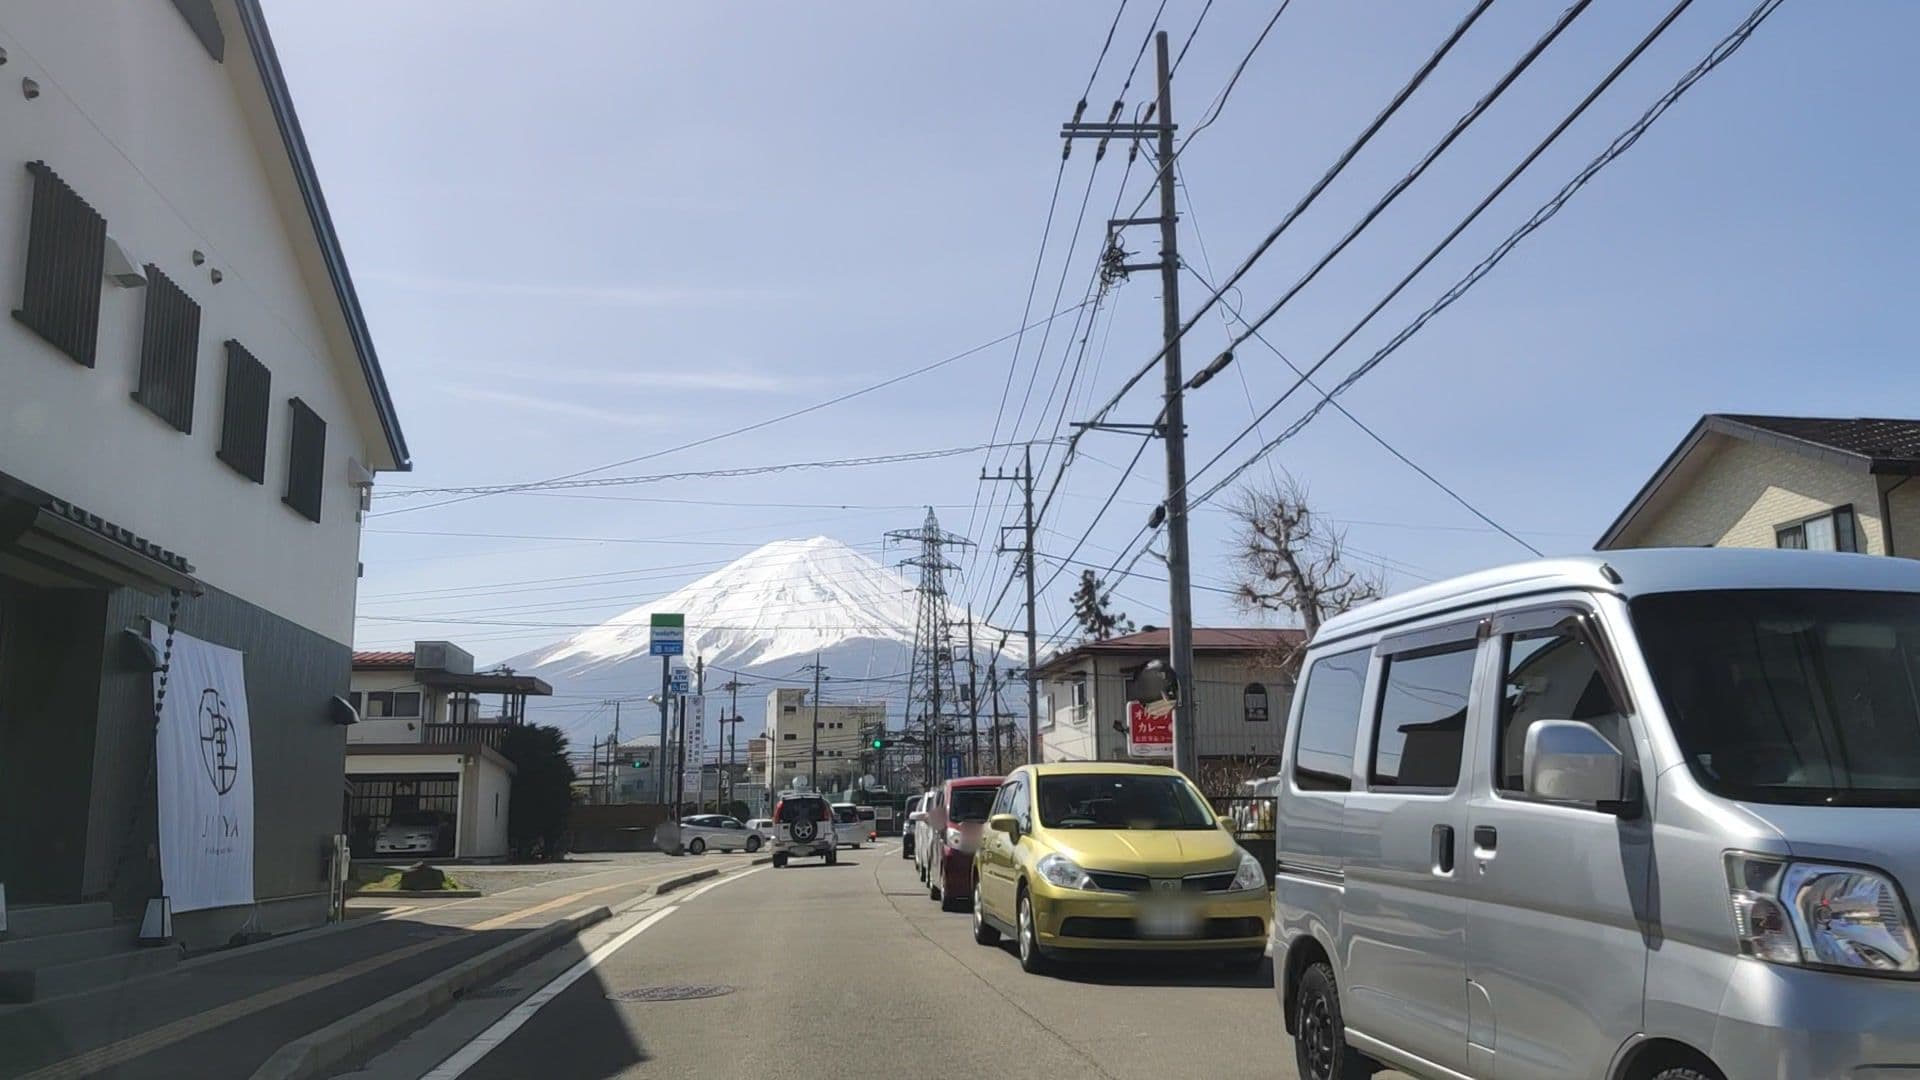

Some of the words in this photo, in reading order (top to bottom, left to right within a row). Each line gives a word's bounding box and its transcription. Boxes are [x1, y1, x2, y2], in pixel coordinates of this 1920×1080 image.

[1137, 722, 1167, 734] カレー
[201, 815, 239, 838] JYA
